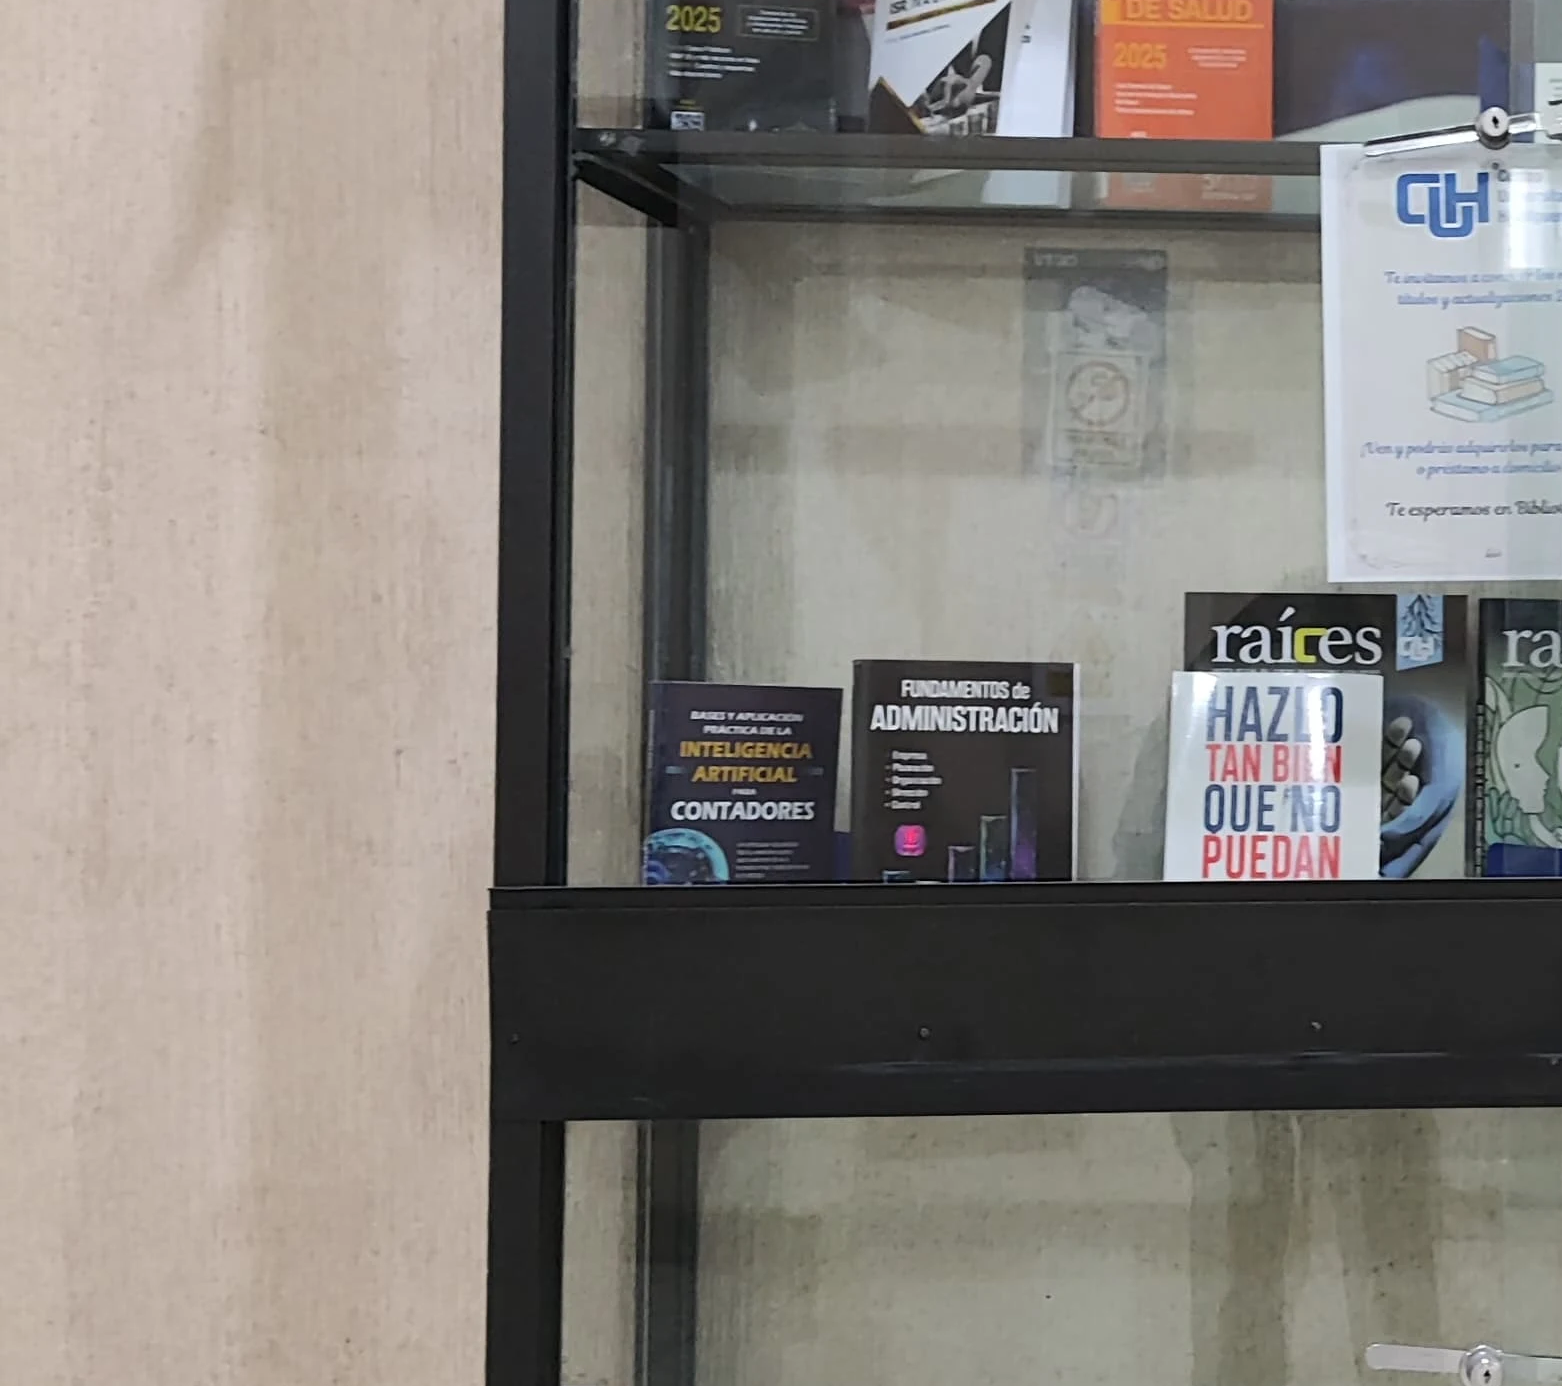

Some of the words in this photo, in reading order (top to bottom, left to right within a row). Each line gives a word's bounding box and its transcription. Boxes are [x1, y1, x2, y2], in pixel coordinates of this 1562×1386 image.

[665, 4, 723, 34] 2025
[1112, 42, 1168, 69] 2025
[1385, 501, 1404, 517] Te
[1408, 505, 1491, 522] esperamos
[1210, 606, 1384, 665] raíces
[900, 679, 1010, 699] FUNDAMENTOS
[1011, 681, 1031, 700] de
[869, 701, 1059, 734] ADMINISTRACIÓN
[679, 740, 814, 759] INTELIGENCIA
[1205, 743, 1261, 782] TAN
[691, 765, 799, 783] ARTIFICIAL
[670, 800, 815, 821] CONTADORES
[1203, 784, 1276, 834] QUE
[1289, 784, 1342, 833] NO
[1202, 834, 1342, 879] PUEDAN
